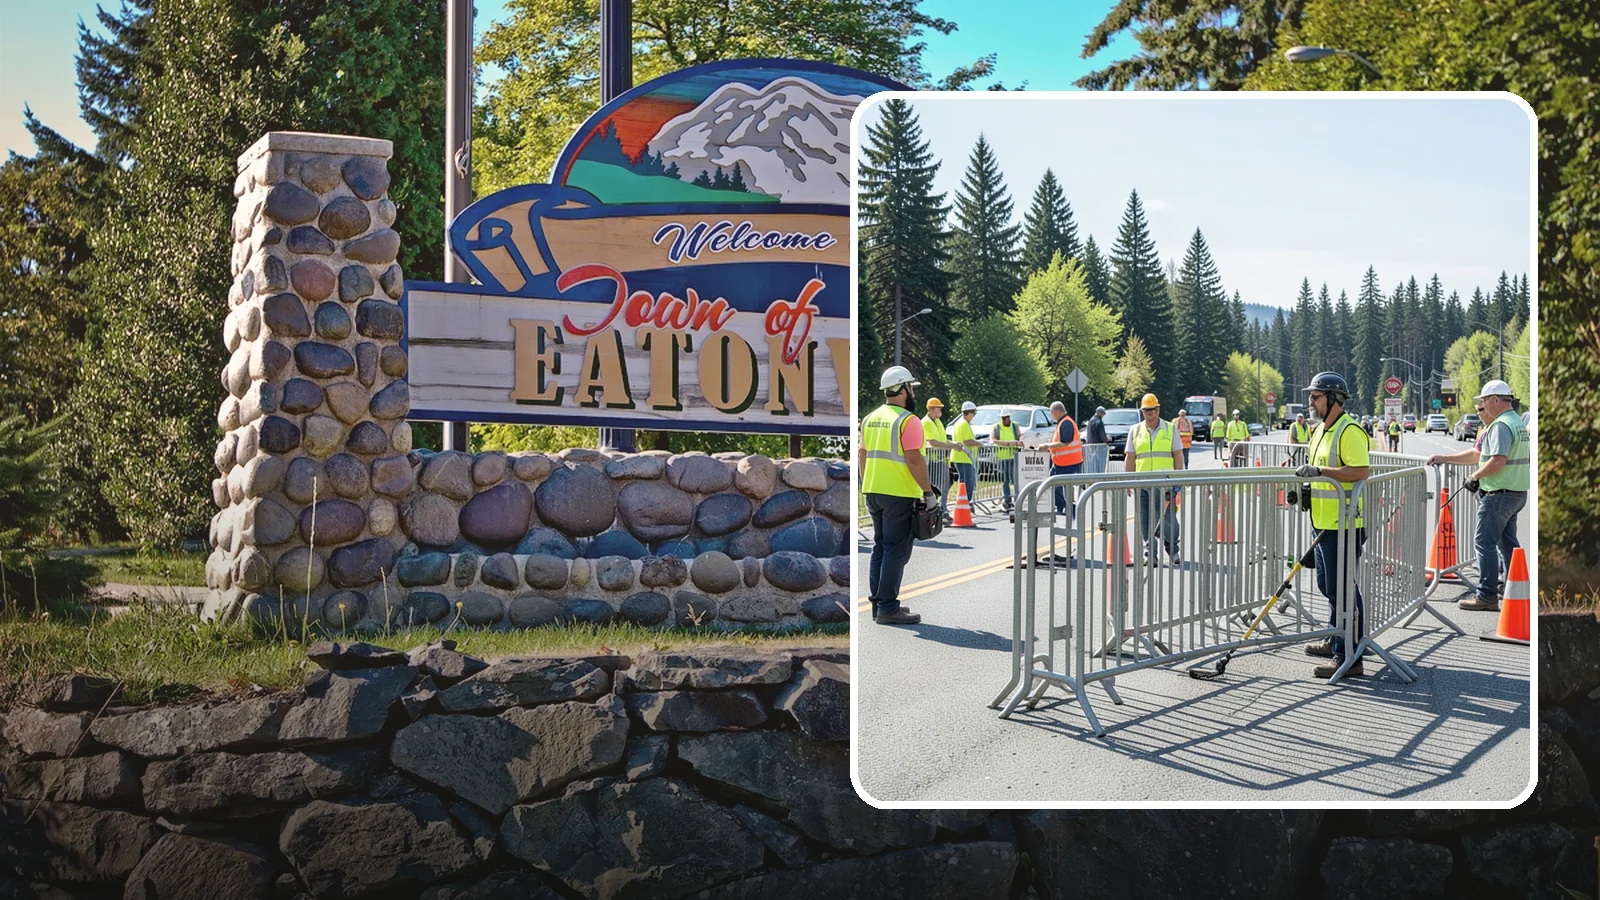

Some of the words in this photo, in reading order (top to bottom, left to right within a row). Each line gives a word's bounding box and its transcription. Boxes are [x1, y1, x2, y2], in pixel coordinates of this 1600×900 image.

[653, 221, 837, 263] Welcome
[557, 263, 737, 337] Town
[765, 278, 826, 365] of
